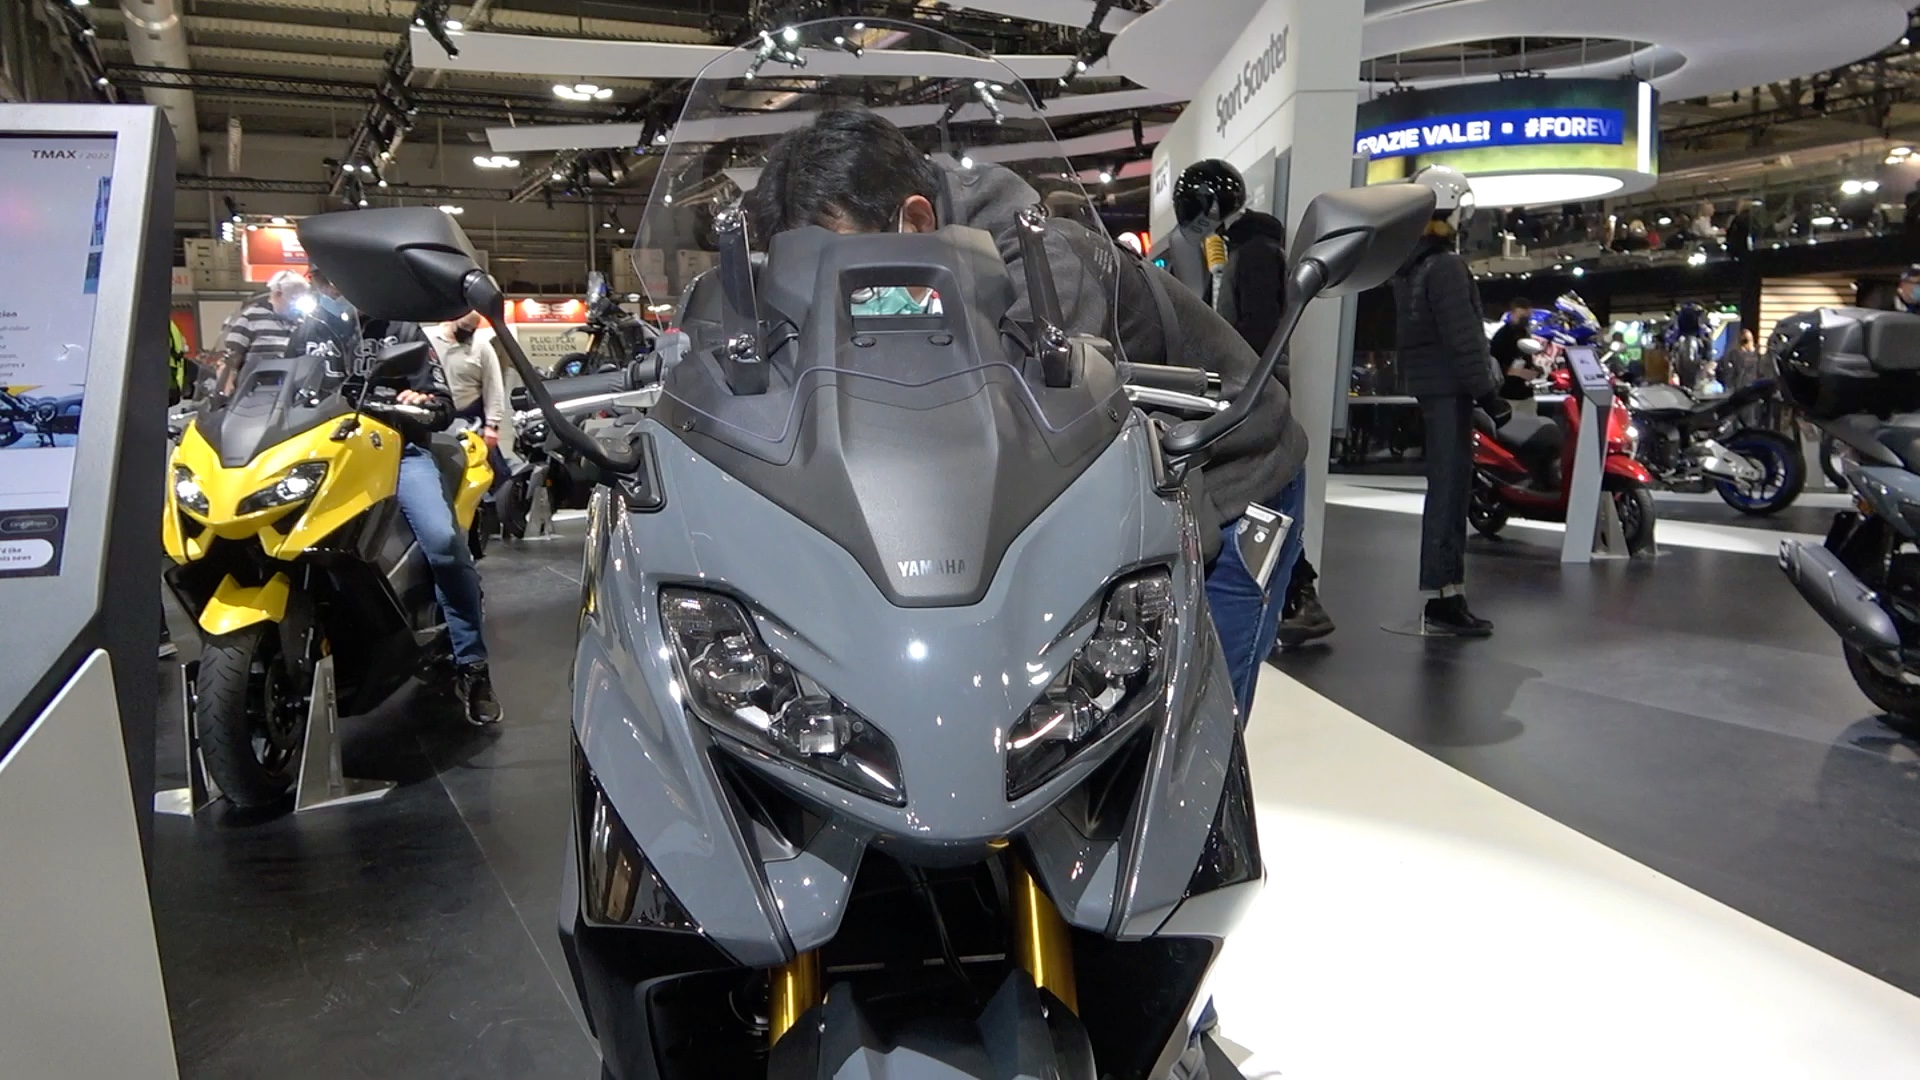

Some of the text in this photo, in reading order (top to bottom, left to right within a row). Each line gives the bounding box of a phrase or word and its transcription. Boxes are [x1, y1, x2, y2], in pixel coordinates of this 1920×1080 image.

[1216, 24, 1289, 139] Sport Scooter
[1422, 121, 1491, 146] VALE!
[31, 149, 77, 159] TMAX
[897, 560, 966, 577] YAMAHA
